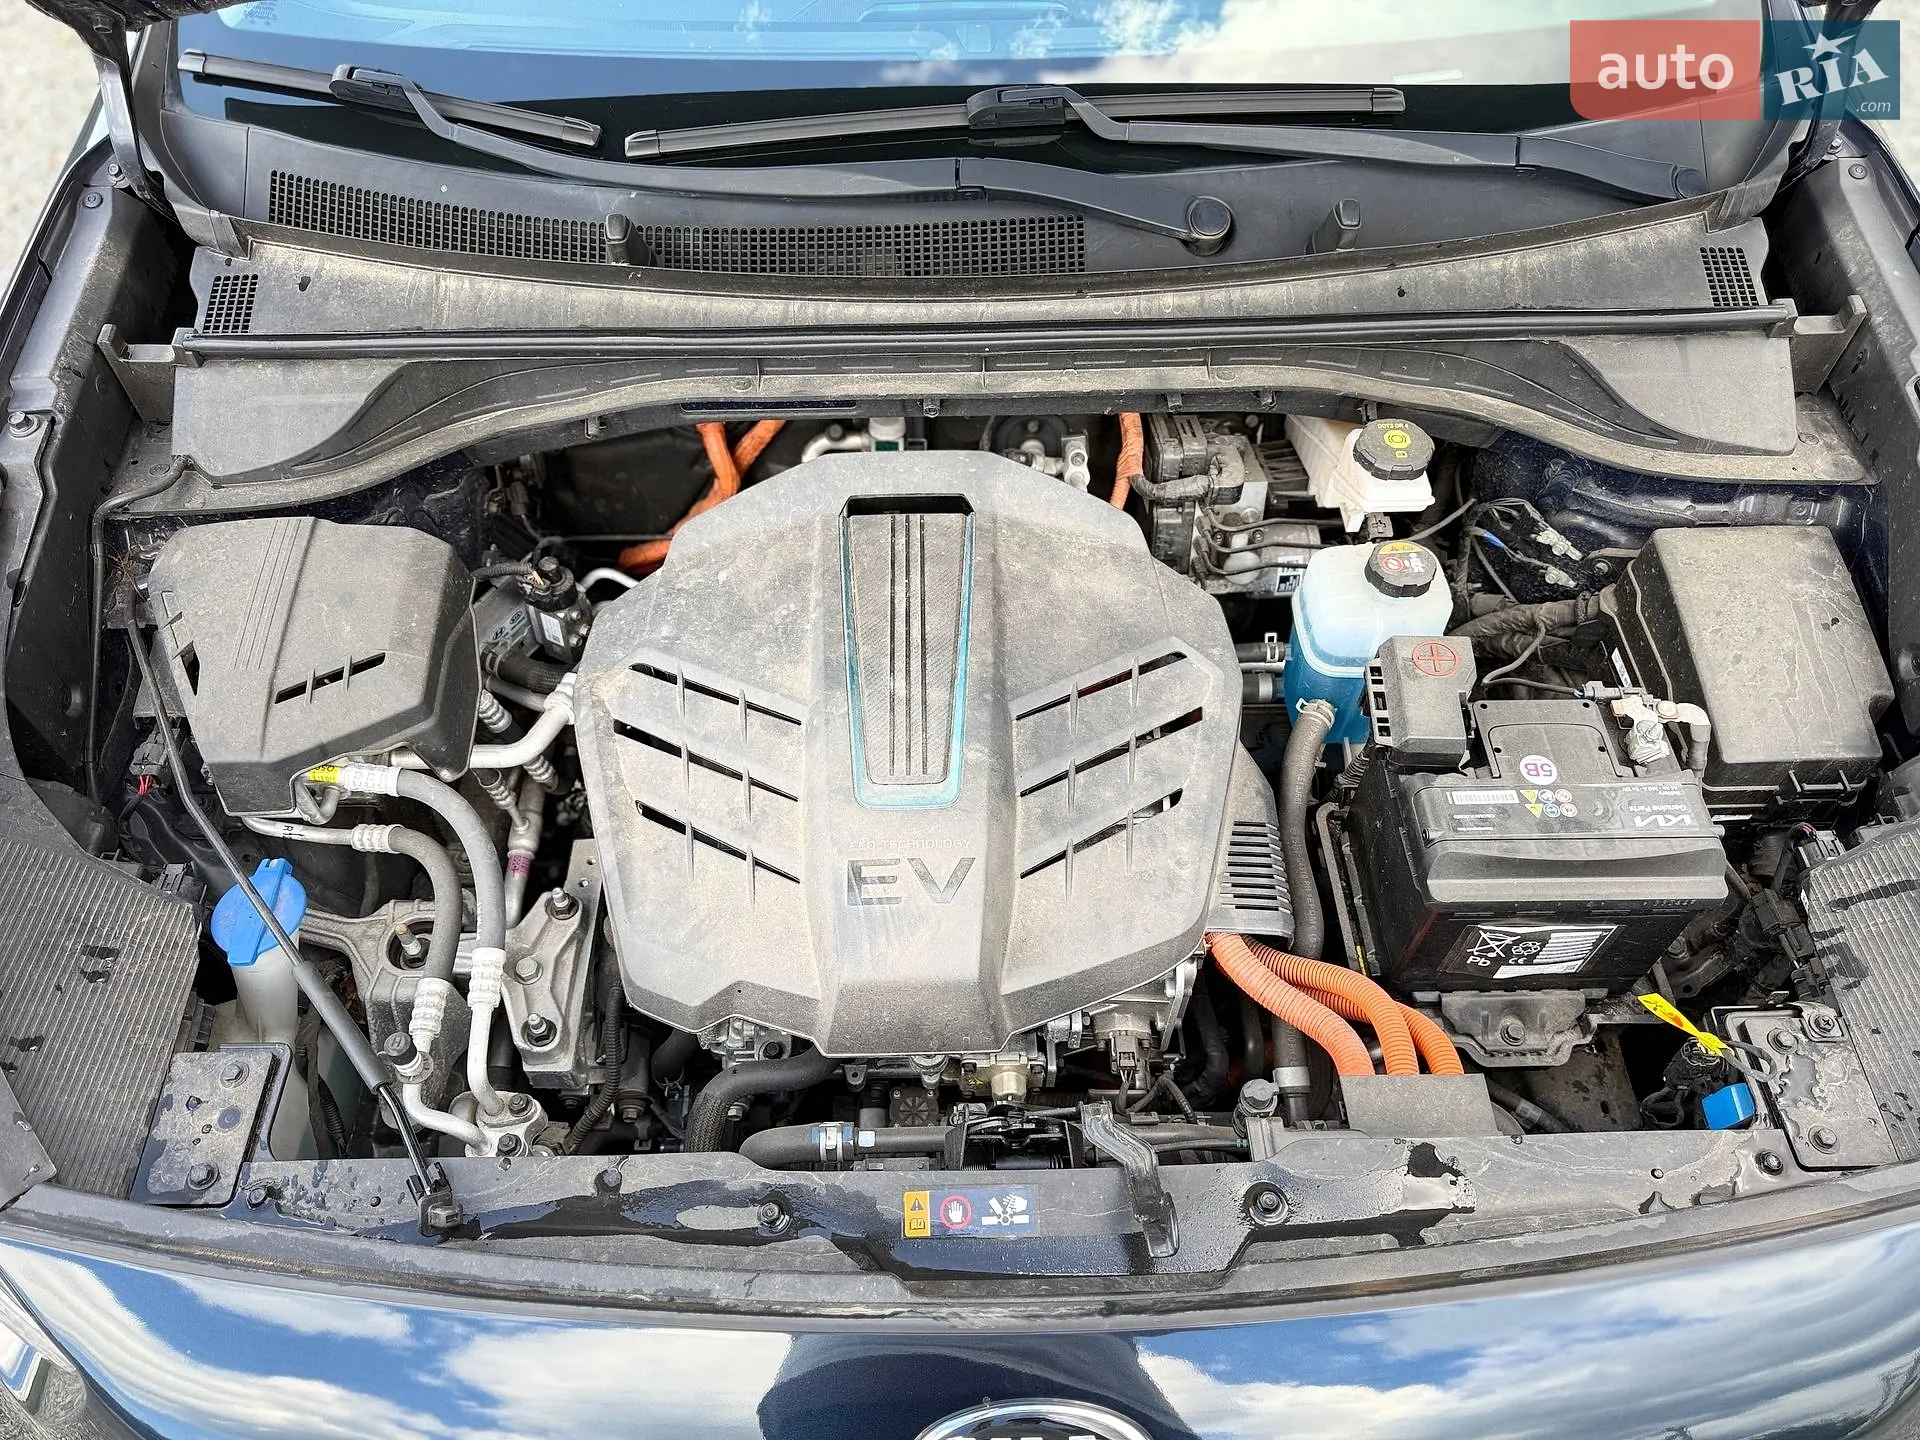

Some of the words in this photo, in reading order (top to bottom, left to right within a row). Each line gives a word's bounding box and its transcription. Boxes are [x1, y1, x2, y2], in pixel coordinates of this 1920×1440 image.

[1524, 763, 1552, 777] 5B
[1652, 804, 1687, 812] Genuine
[847, 857, 976, 907] EV
[1466, 955, 1491, 967] Pb
